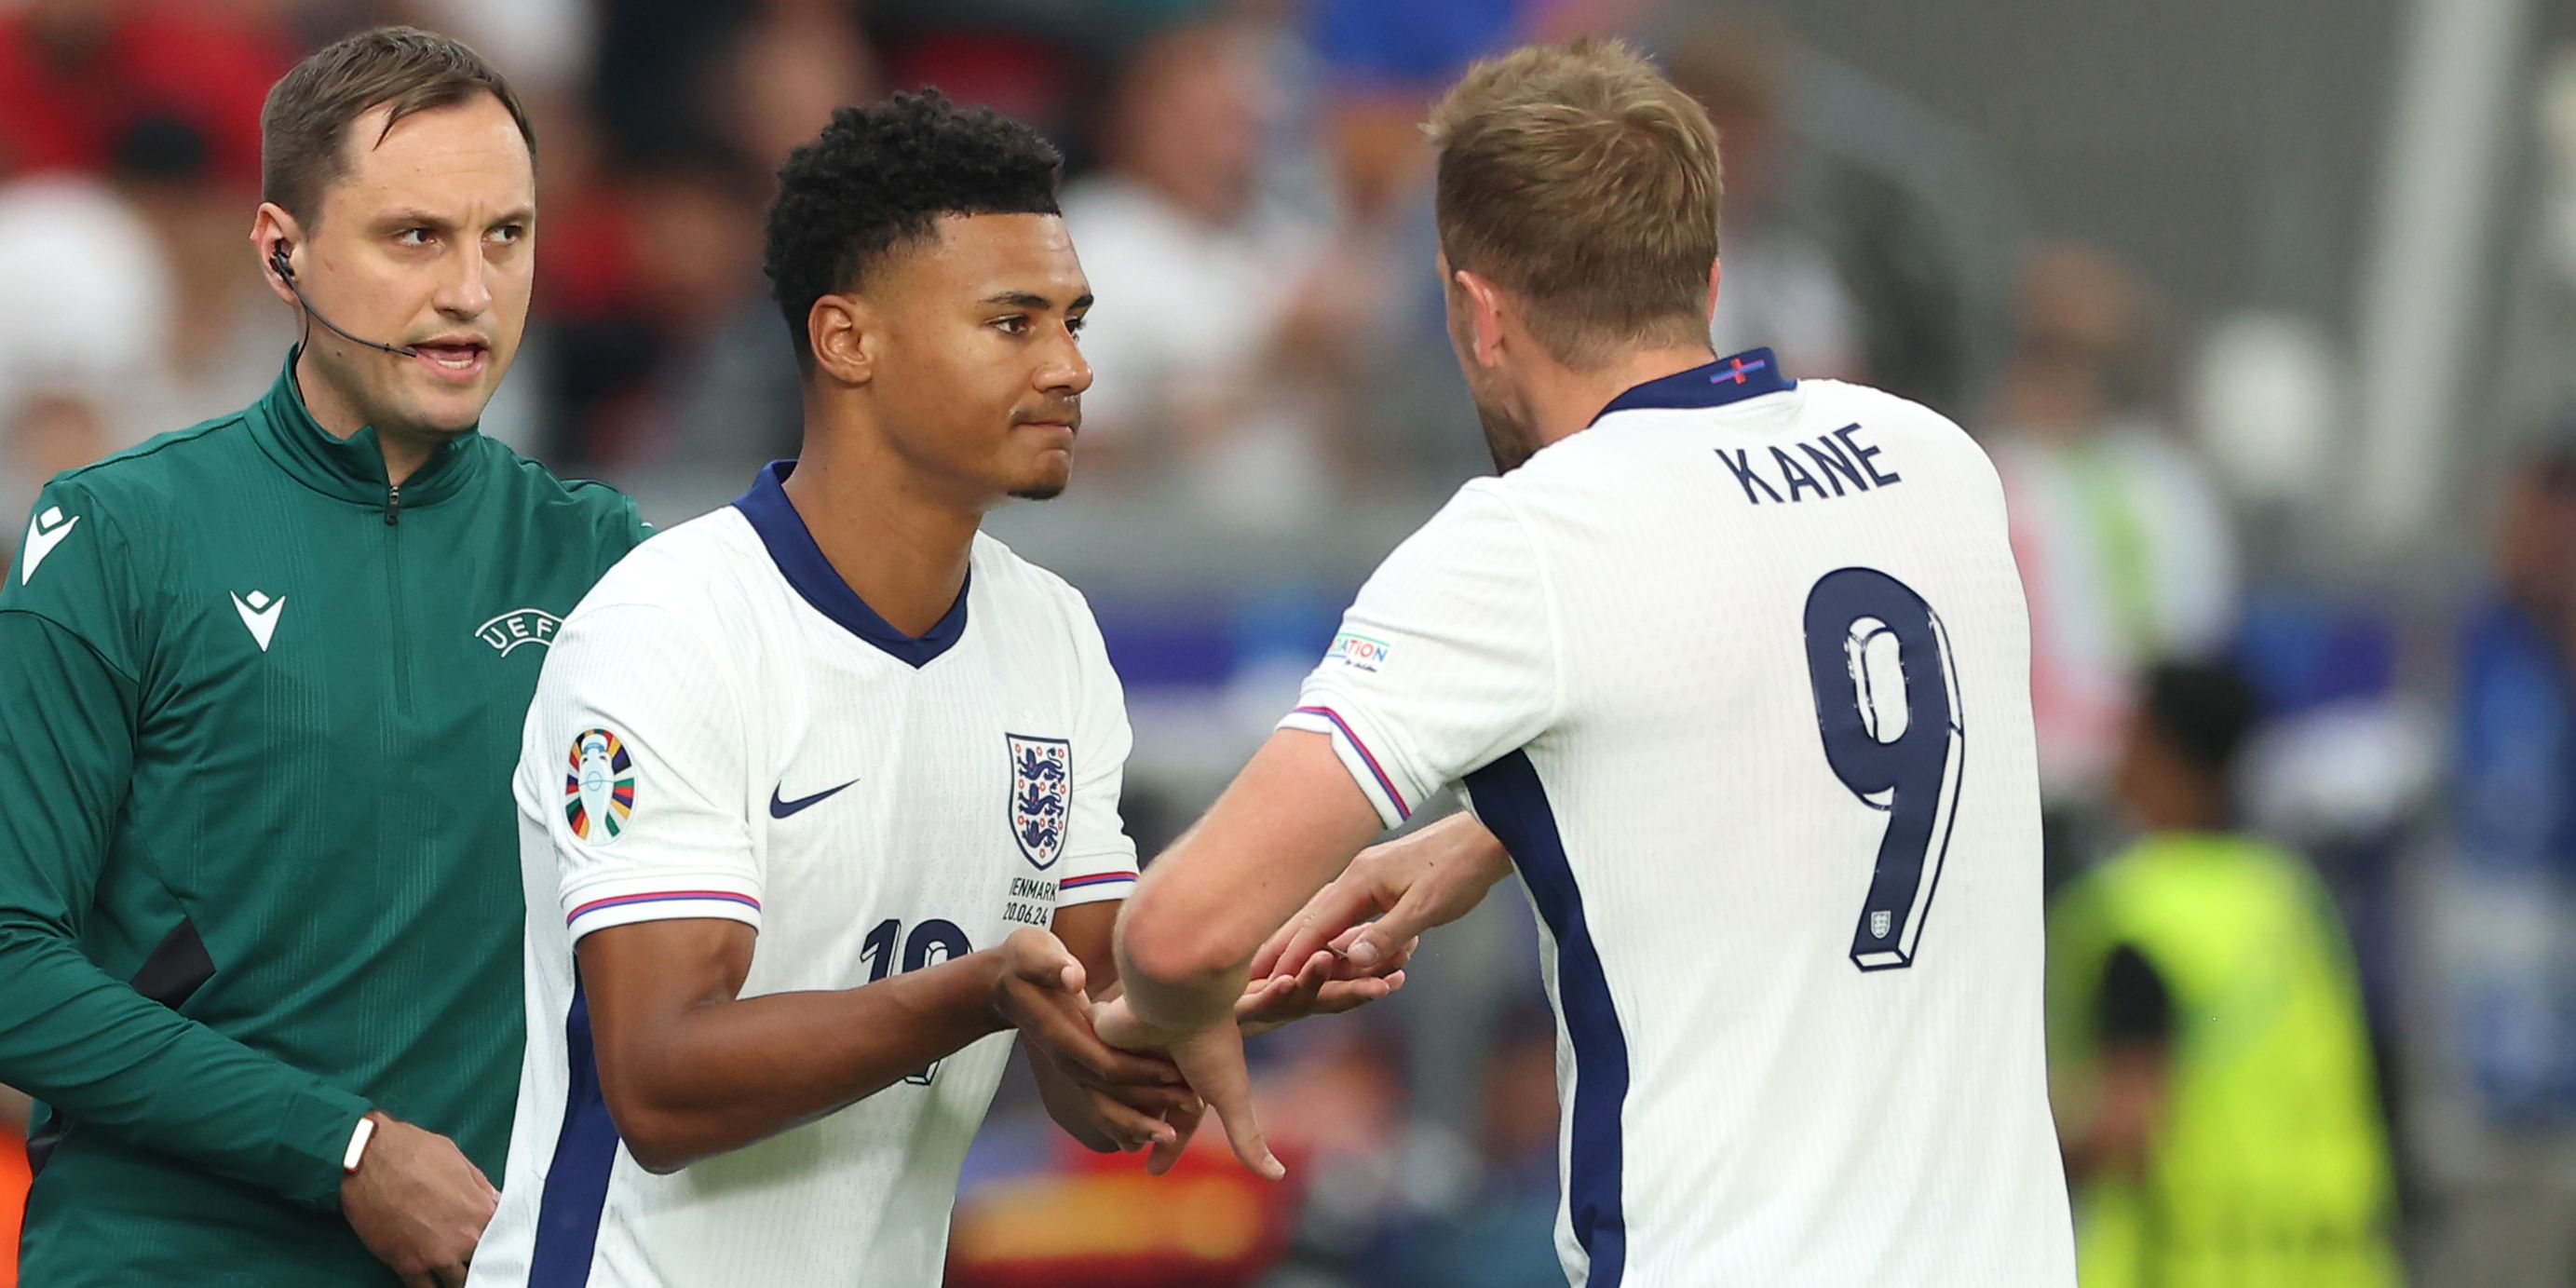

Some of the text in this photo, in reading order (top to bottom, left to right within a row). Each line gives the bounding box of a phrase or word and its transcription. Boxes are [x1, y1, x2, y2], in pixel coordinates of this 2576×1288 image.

[1714, 422, 1901, 504] KANE
[482, 617, 554, 649] UEF
[1804, 566, 1964, 972] 9
[1003, 902, 1049, 927] 20.06.24
